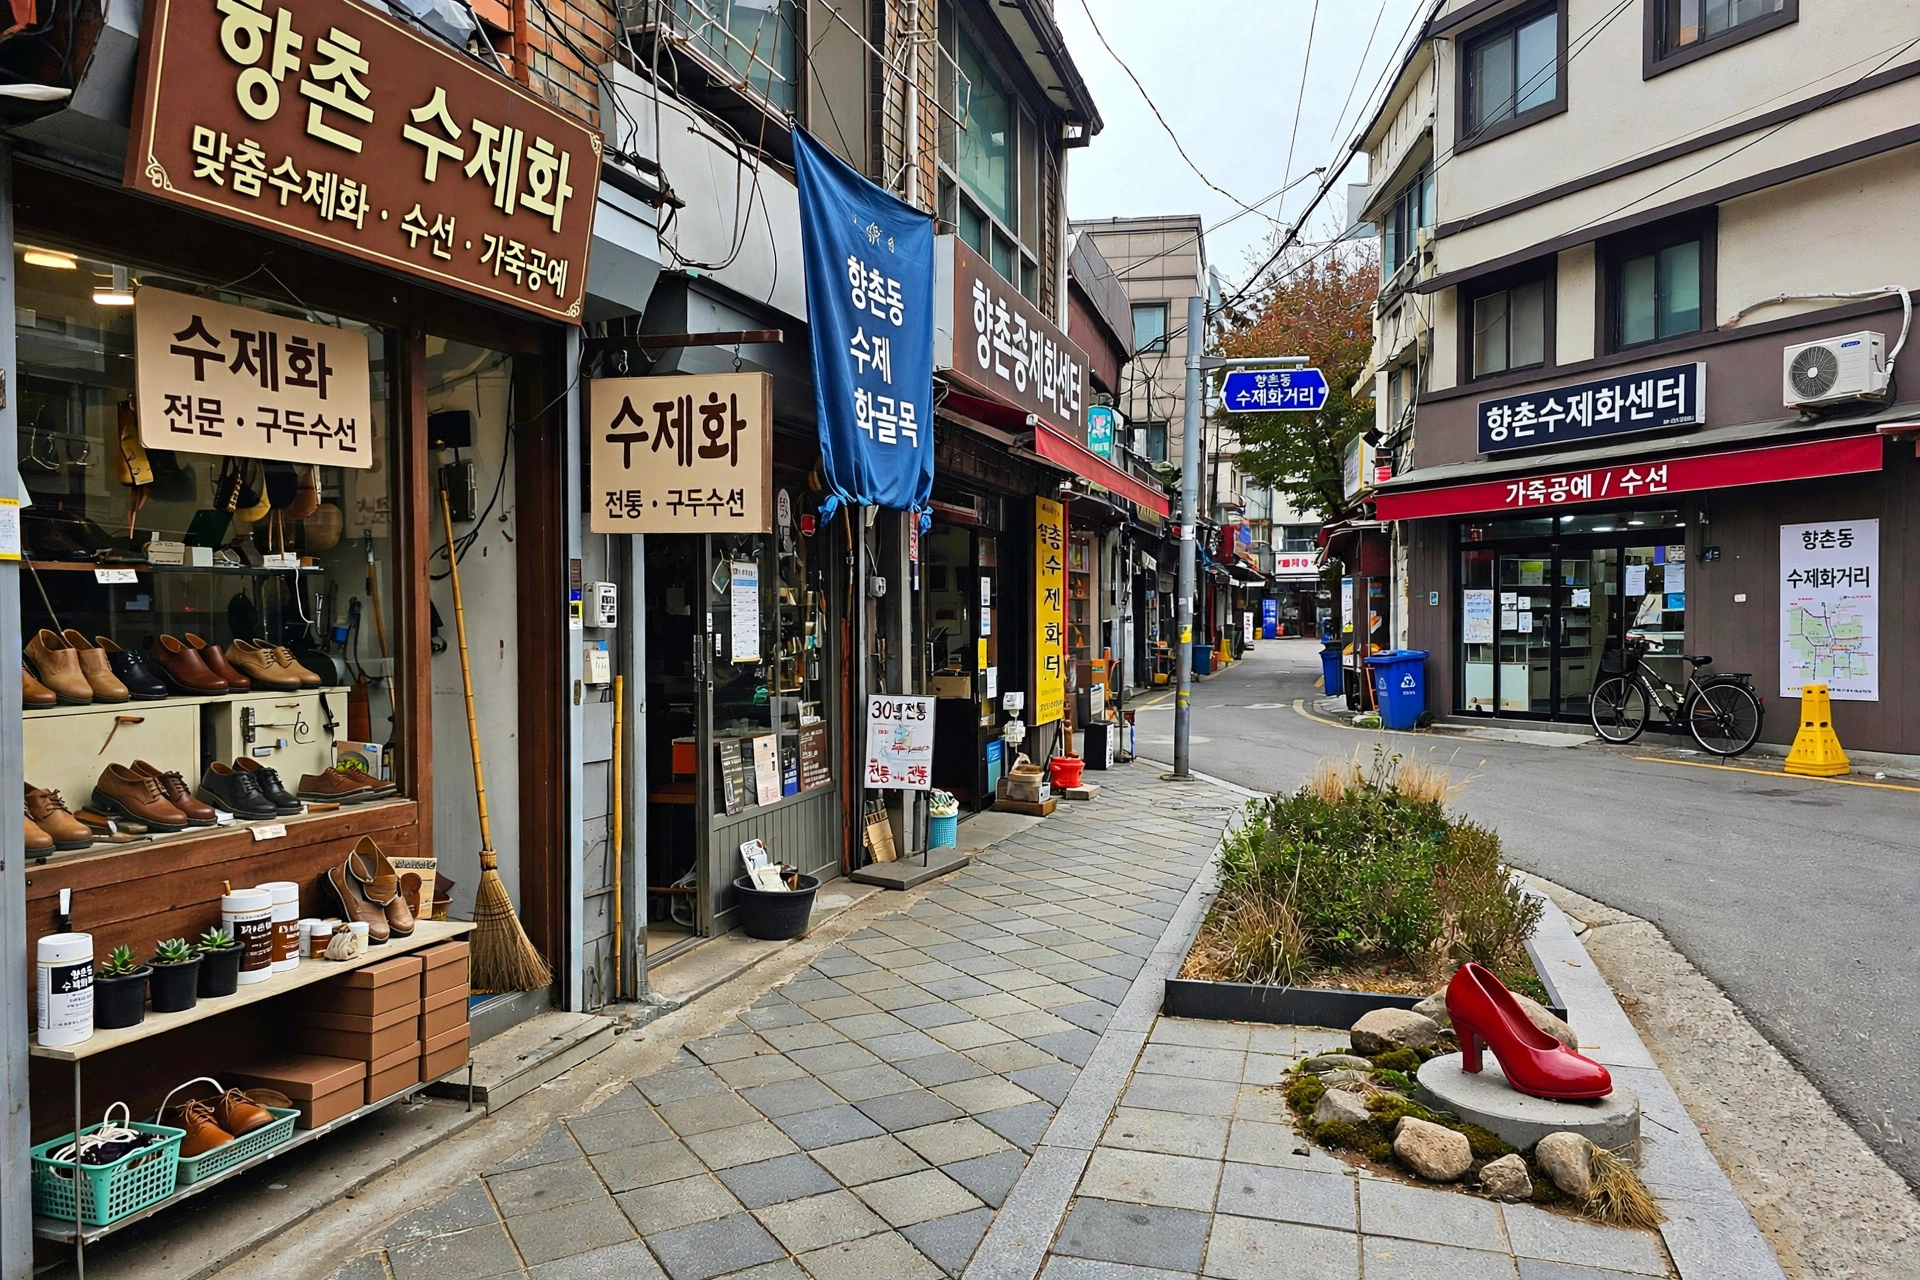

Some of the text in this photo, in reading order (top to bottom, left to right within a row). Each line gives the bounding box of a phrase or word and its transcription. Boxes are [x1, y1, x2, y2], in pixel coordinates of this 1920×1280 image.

[216, 0, 574, 234] 향촌 수제화
[191, 124, 370, 230] 맞춤수제화
[401, 203, 457, 260] 수선
[480, 233, 569, 298] 가죽공예
[847, 254, 904, 327] 향촌동
[169, 314, 333, 400] 수제화
[850, 326, 892, 385] 수제
[163, 393, 225, 438] 전문
[255, 406, 357, 453] 구두수선
[853, 387, 918, 448] 화골목
[1235, 387, 1314, 407] 수제화거리
[1486, 373, 1686, 442] 향촌수제화센터
[605, 391, 748, 470] 수제화
[605, 489, 643, 519] 전통
[1505, 473, 1592, 506] 가죽공예
[1619, 464, 1668, 495] 수선
[1801, 527, 1855, 550] 향촌동
[1786, 566, 1870, 589] 수제화거리
